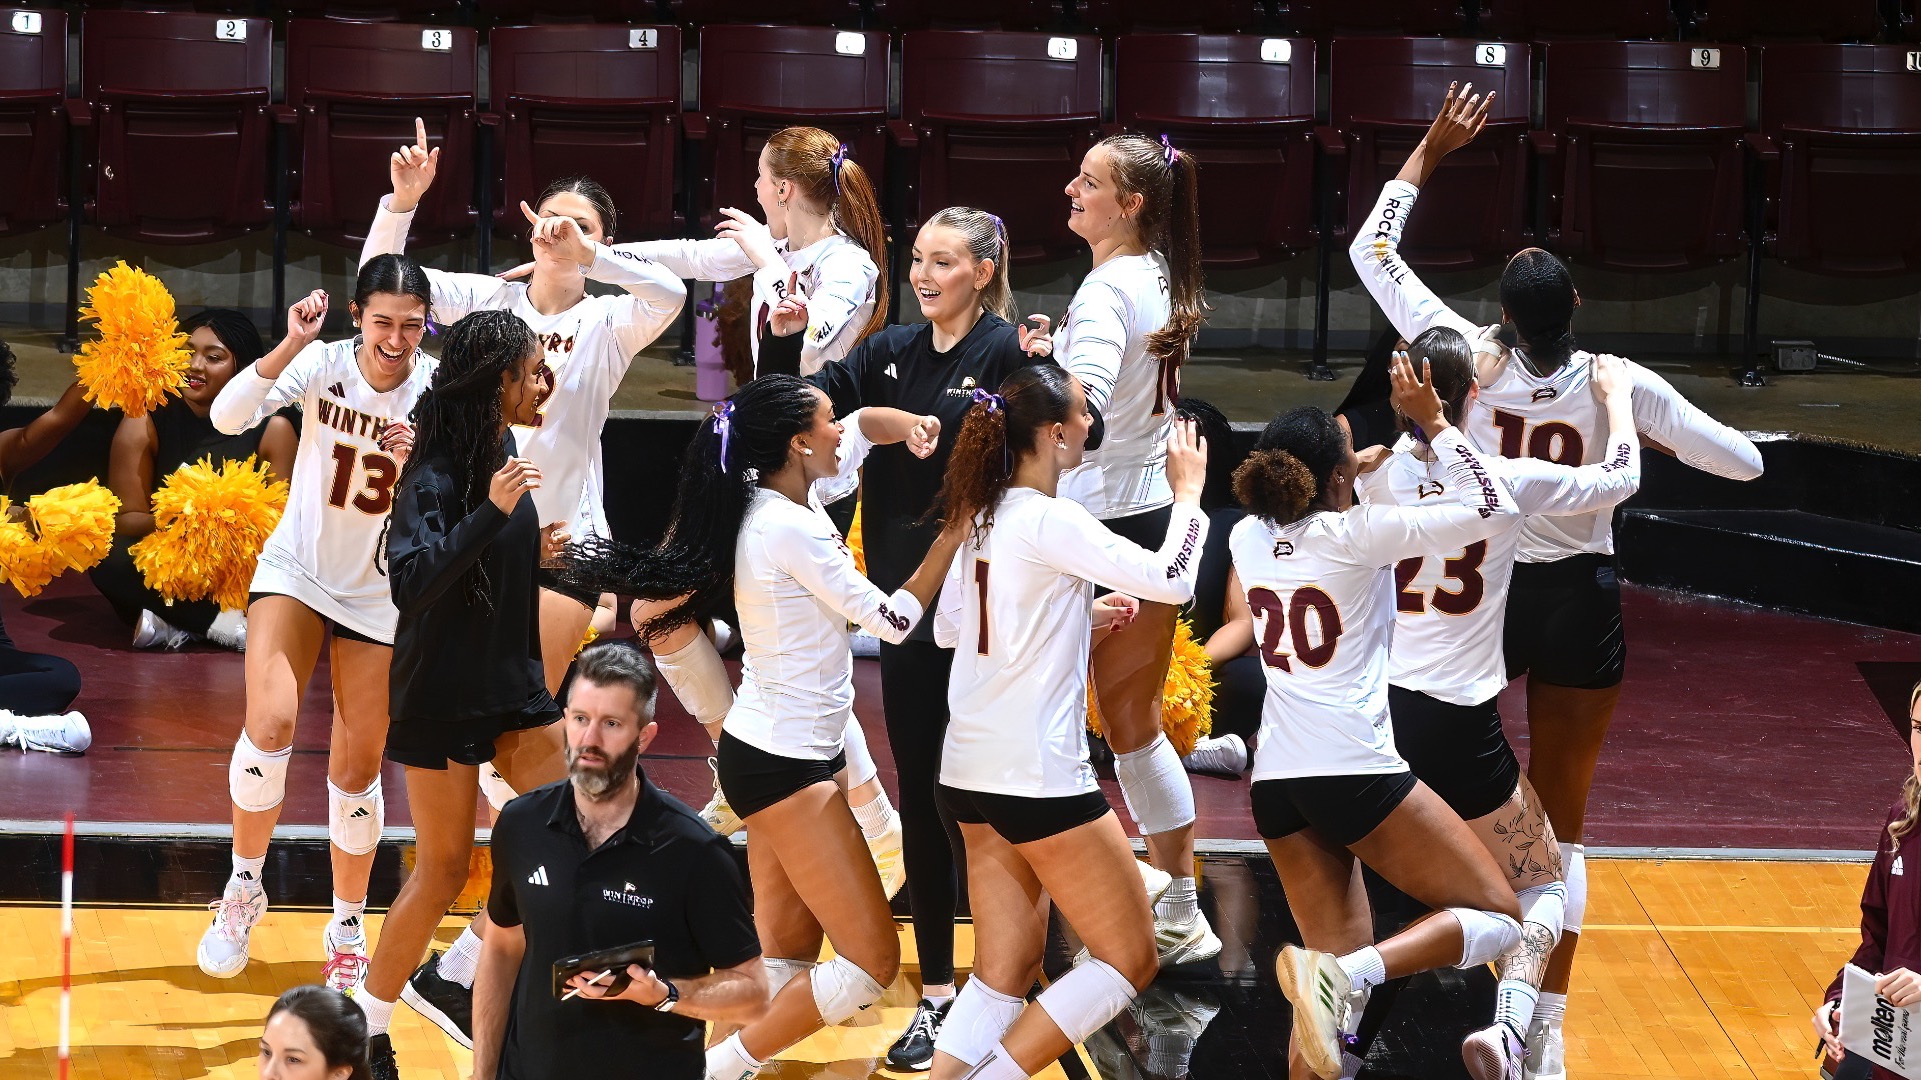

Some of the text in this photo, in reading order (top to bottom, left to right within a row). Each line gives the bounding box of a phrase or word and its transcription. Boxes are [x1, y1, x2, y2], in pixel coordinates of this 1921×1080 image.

[21, 14, 30, 30] 1
[226, 20, 237, 38] 2
[431, 31, 441, 48] 3
[638, 30, 648, 47] 4
[1485, 46, 1495, 63] 8
[1700, 49, 1711, 67] 9
[1376, 197, 1401, 239] ROCK
[327, 440, 400, 516] 13
[1395, 536, 1488, 617] 23
[975, 557, 991, 656] 1
[1246, 584, 1344, 674] 20
[1871, 997, 1895, 1061] molten
